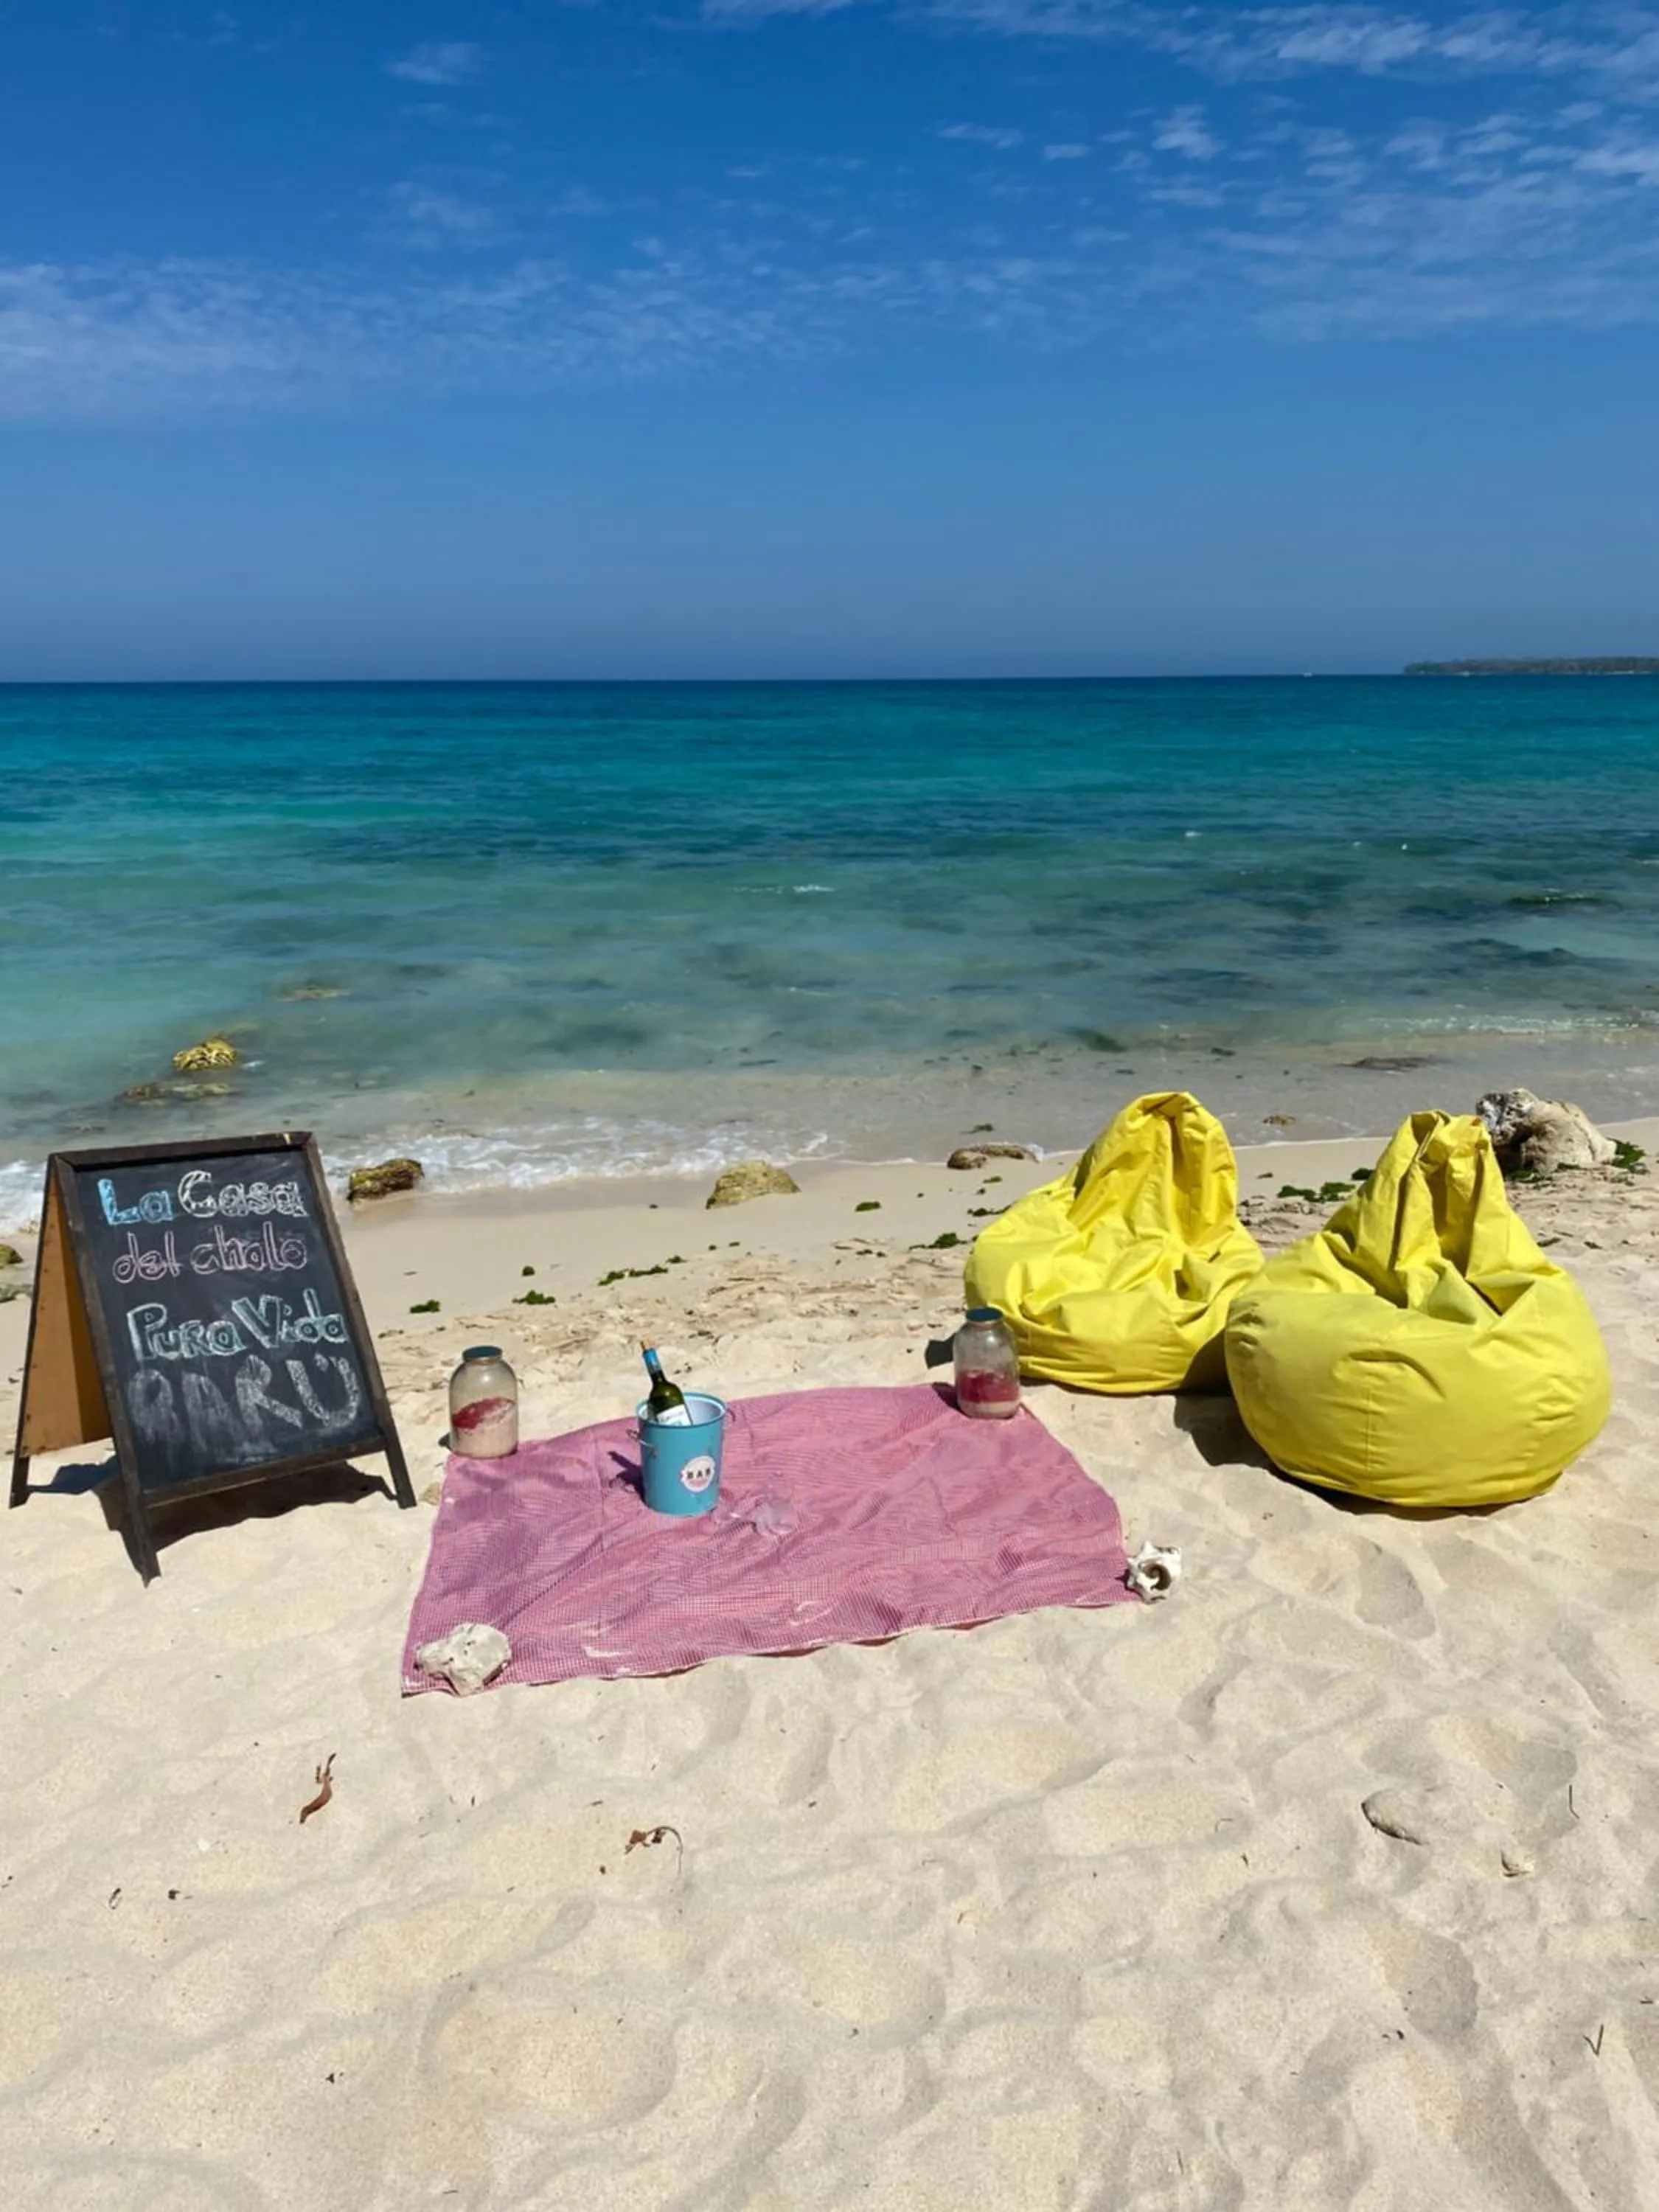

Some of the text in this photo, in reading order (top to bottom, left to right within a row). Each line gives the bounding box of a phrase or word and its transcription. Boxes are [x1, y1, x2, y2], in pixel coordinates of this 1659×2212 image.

[97, 1170, 307, 1226] La Casa
[112, 1231, 182, 1284] del
[232, 1288, 349, 1349] Vida
